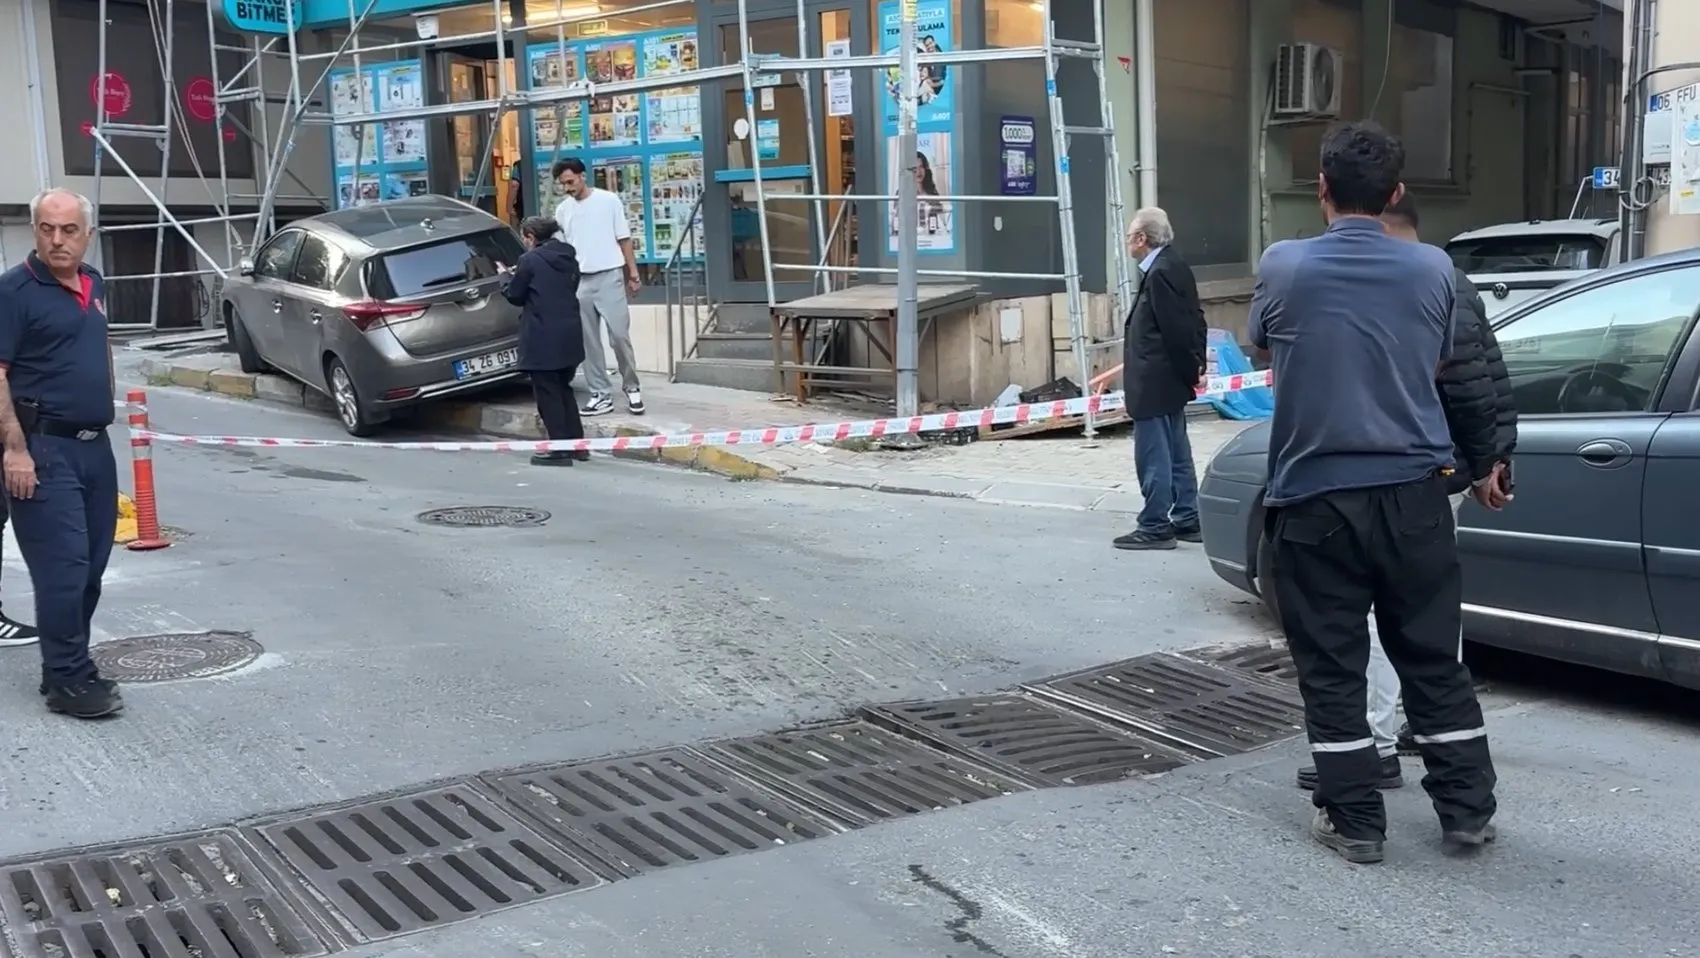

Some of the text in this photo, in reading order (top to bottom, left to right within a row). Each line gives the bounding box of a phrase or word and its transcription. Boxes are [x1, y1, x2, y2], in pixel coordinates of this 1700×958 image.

[917, 22, 945, 32] ULAMA
[1677, 85, 1697, 102] FFU
[462, 360, 475, 374] 34
[497, 349, 517, 364] 091
